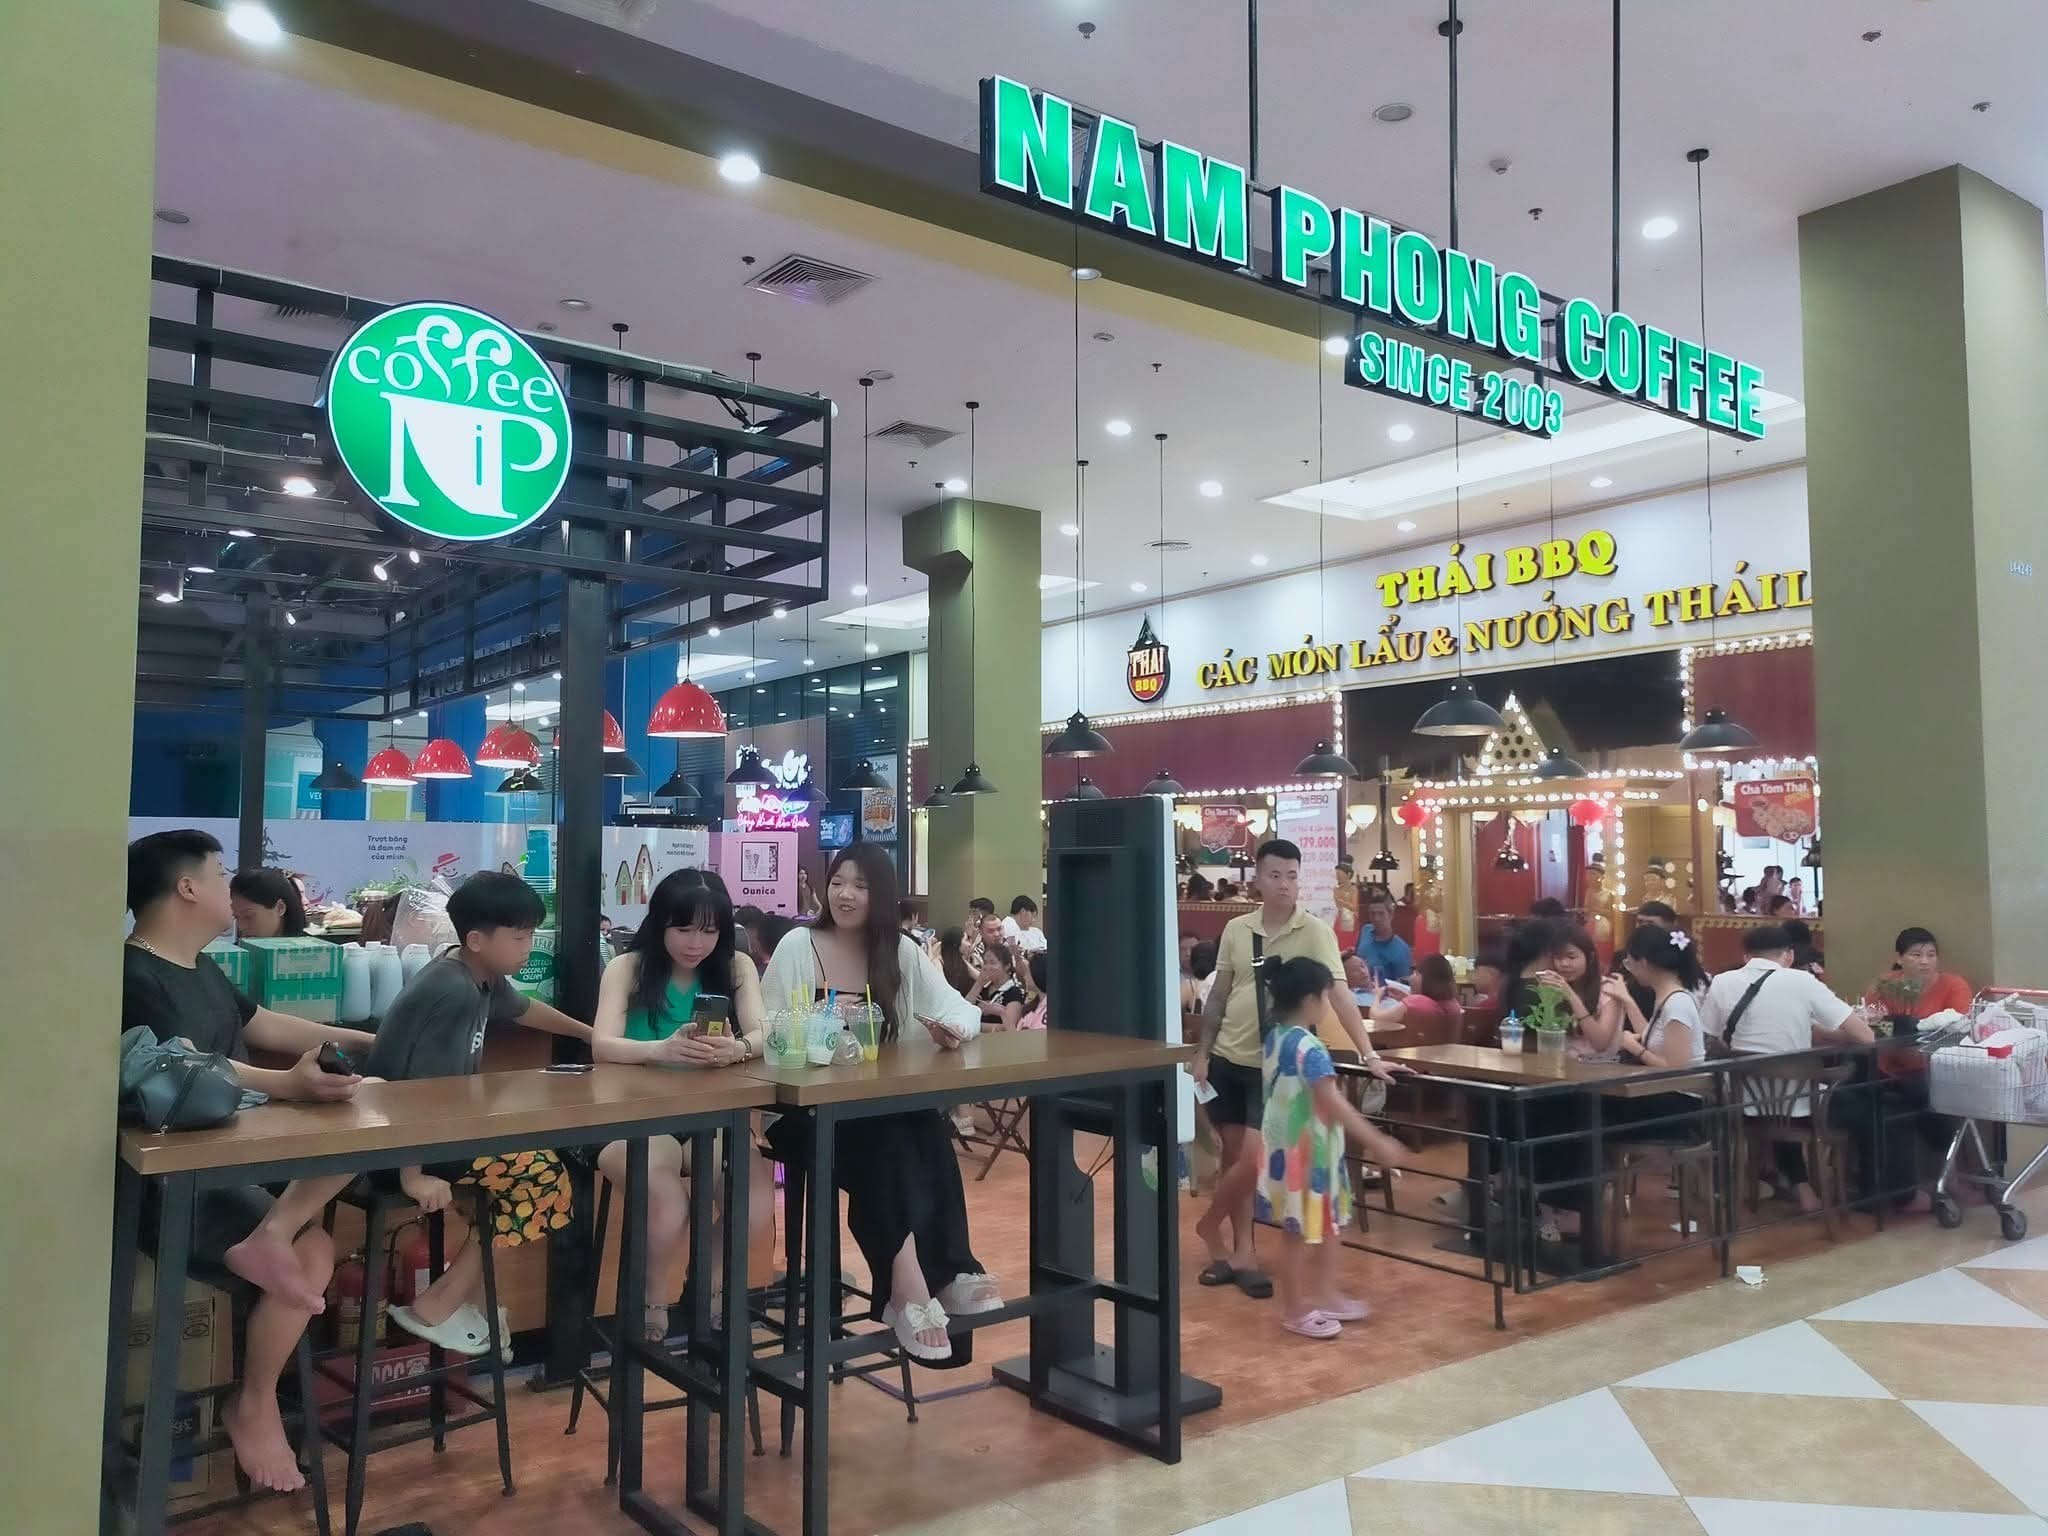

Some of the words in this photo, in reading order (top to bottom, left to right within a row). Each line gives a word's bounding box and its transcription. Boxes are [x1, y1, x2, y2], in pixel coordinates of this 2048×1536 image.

[995, 74, 1248, 266] NAM
[1281, 184, 1542, 363] PHONG
[1564, 297, 1766, 439] COFFEE
[348, 314, 554, 413] coffee
[1360, 331, 1472, 412] SINCE
[1482, 371, 1563, 435] 2003
[1376, 543, 1495, 607] THÁI
[1504, 529, 1618, 586] BBQ
[1129, 646, 1165, 678] THAI
[1135, 678, 1158, 692] BBQ
[1198, 648, 1258, 690] CÁC
[1267, 634, 1343, 681] MÓN
[1464, 591, 1634, 654] NƯỚNG
